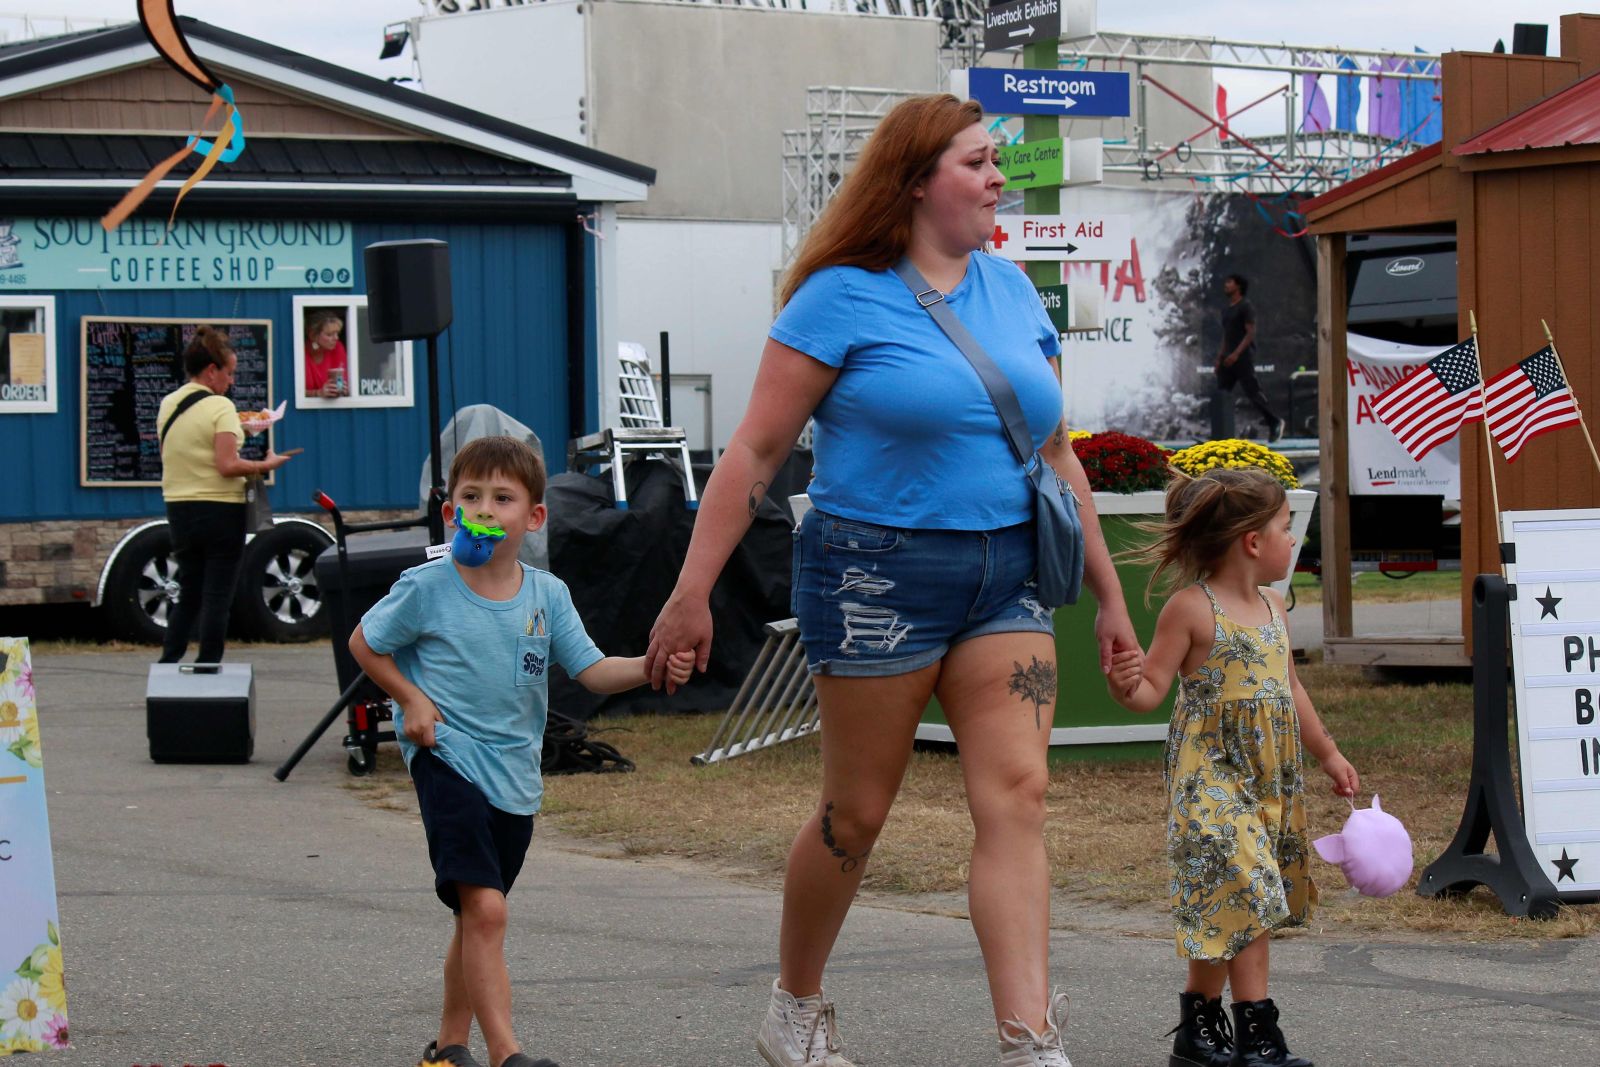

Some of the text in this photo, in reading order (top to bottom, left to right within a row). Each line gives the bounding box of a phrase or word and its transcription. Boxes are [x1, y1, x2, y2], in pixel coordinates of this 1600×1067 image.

[986, 0, 1058, 29] Livestock Exhibits
[1003, 73, 1096, 96] Restroom
[1014, 150, 1031, 164] Care
[1034, 146, 1060, 161] Center
[215, 218, 345, 254] GROUND
[1023, 221, 1103, 238] First Aid
[111, 257, 274, 283] COFFEE SHOP
[1, 384, 45, 401] ORDER
[1368, 466, 1427, 480] Lendmark
